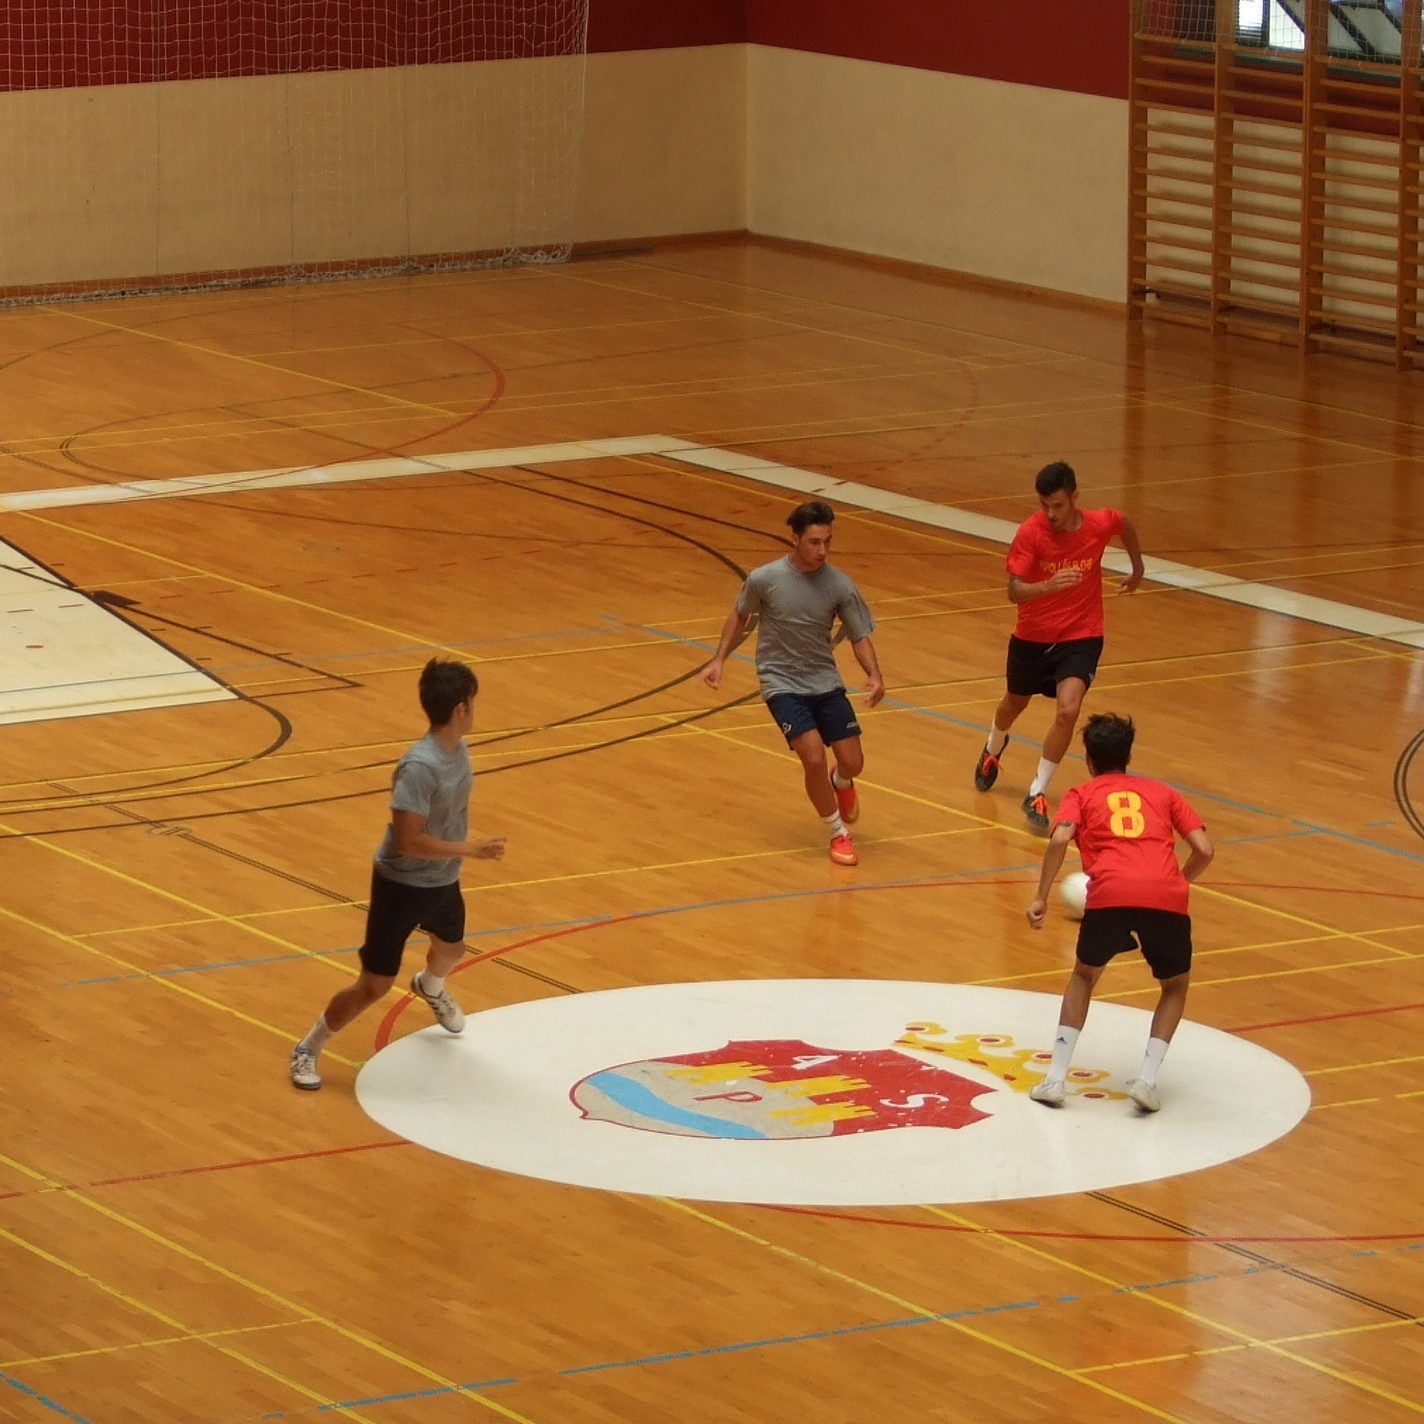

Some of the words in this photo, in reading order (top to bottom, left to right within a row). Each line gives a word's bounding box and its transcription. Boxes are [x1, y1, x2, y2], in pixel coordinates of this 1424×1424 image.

[1107, 790, 1145, 838] 8
[791, 1053, 843, 1070] A
[692, 1090, 763, 1103] P
[879, 1092, 950, 1109] S
